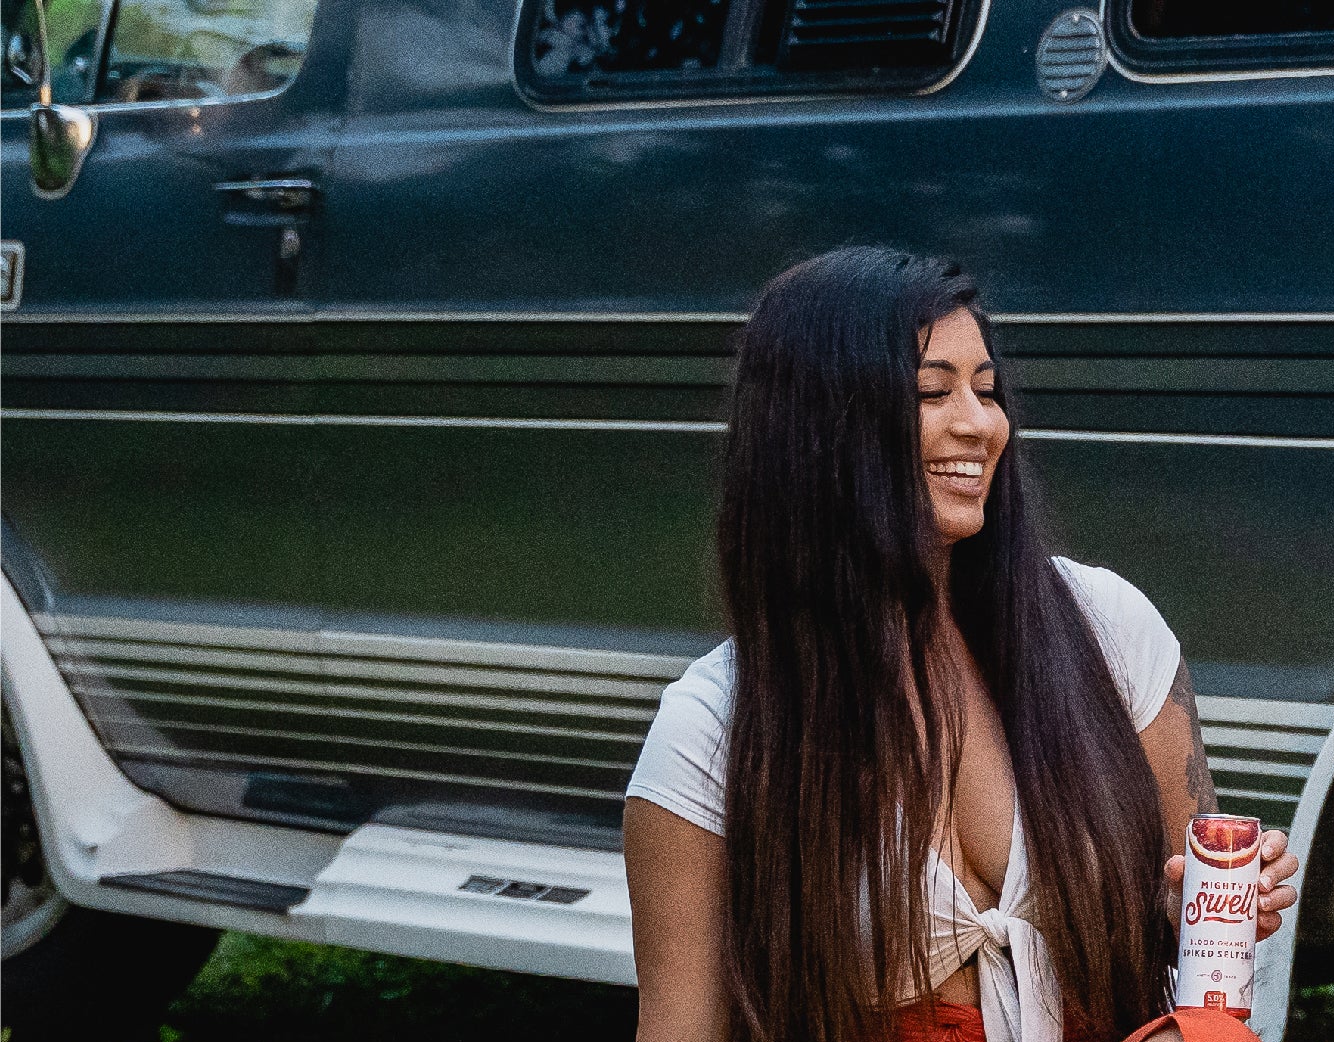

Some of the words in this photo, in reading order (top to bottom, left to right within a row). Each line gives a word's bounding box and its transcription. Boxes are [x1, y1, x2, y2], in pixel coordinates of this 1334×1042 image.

[1200, 881, 1243, 891] MIGHTY
[1185, 883, 1257, 926] Swell
[1183, 949, 1214, 958] SPIKED
